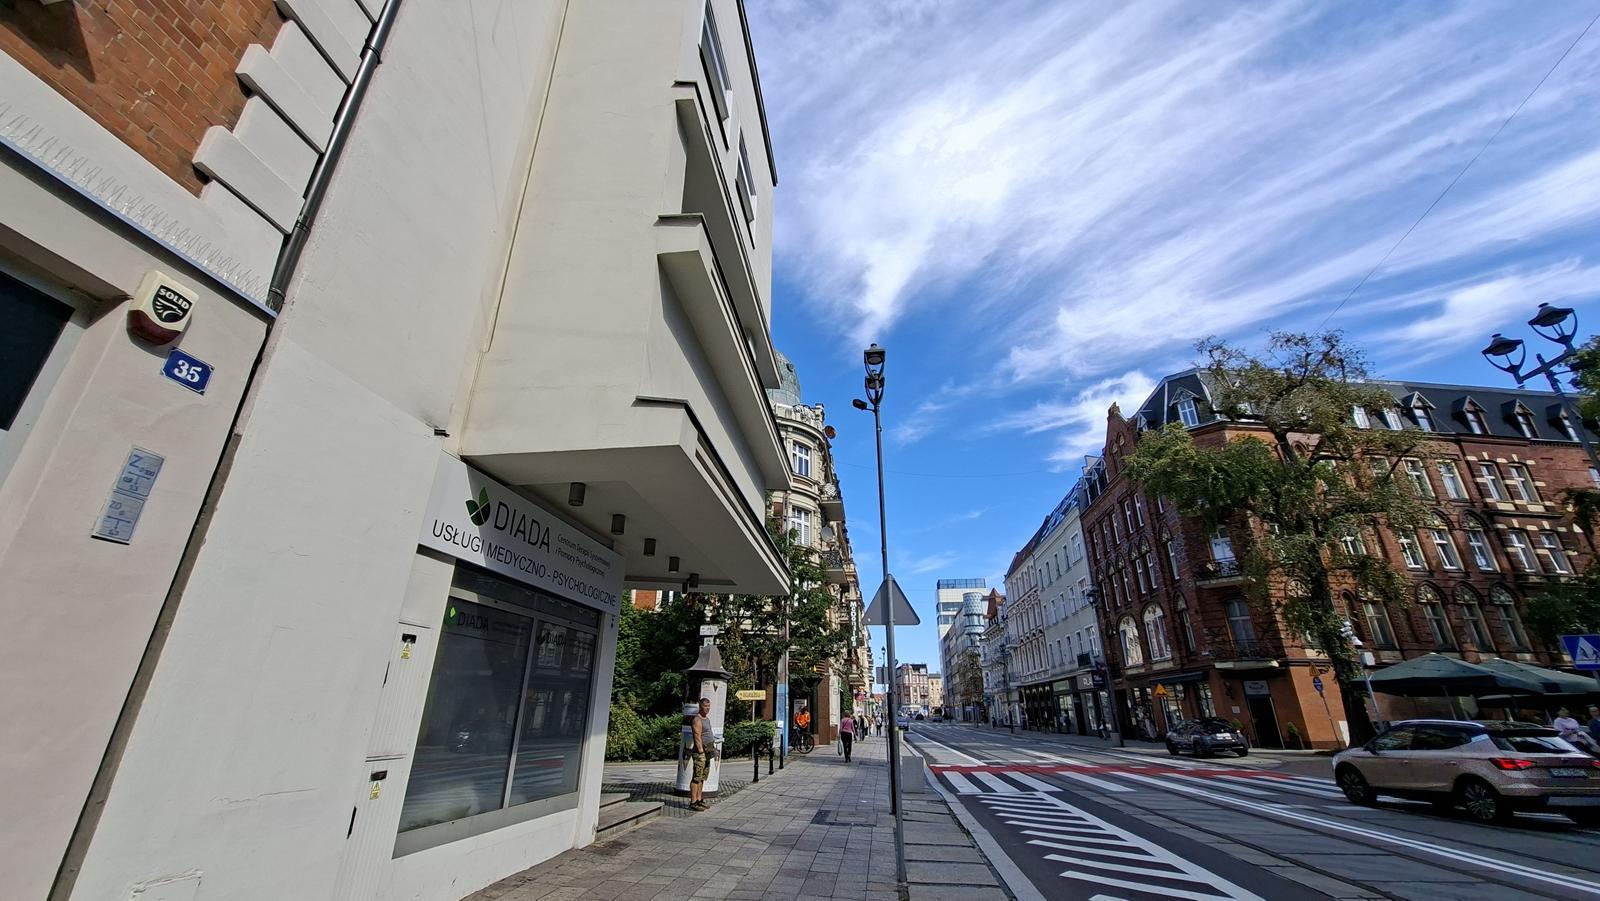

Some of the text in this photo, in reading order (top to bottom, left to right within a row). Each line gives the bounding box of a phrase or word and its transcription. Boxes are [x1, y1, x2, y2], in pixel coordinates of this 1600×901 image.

[158, 288, 190, 310] SOLID
[173, 359, 203, 383] 35
[493, 500, 551, 554] DIADA
[432, 519, 485, 554] USŁUGI
[486, 542, 546, 579] MEDYCZNO
[552, 570, 617, 607] PSYCHOLOGICZNE
[457, 611, 489, 633] DIADA
